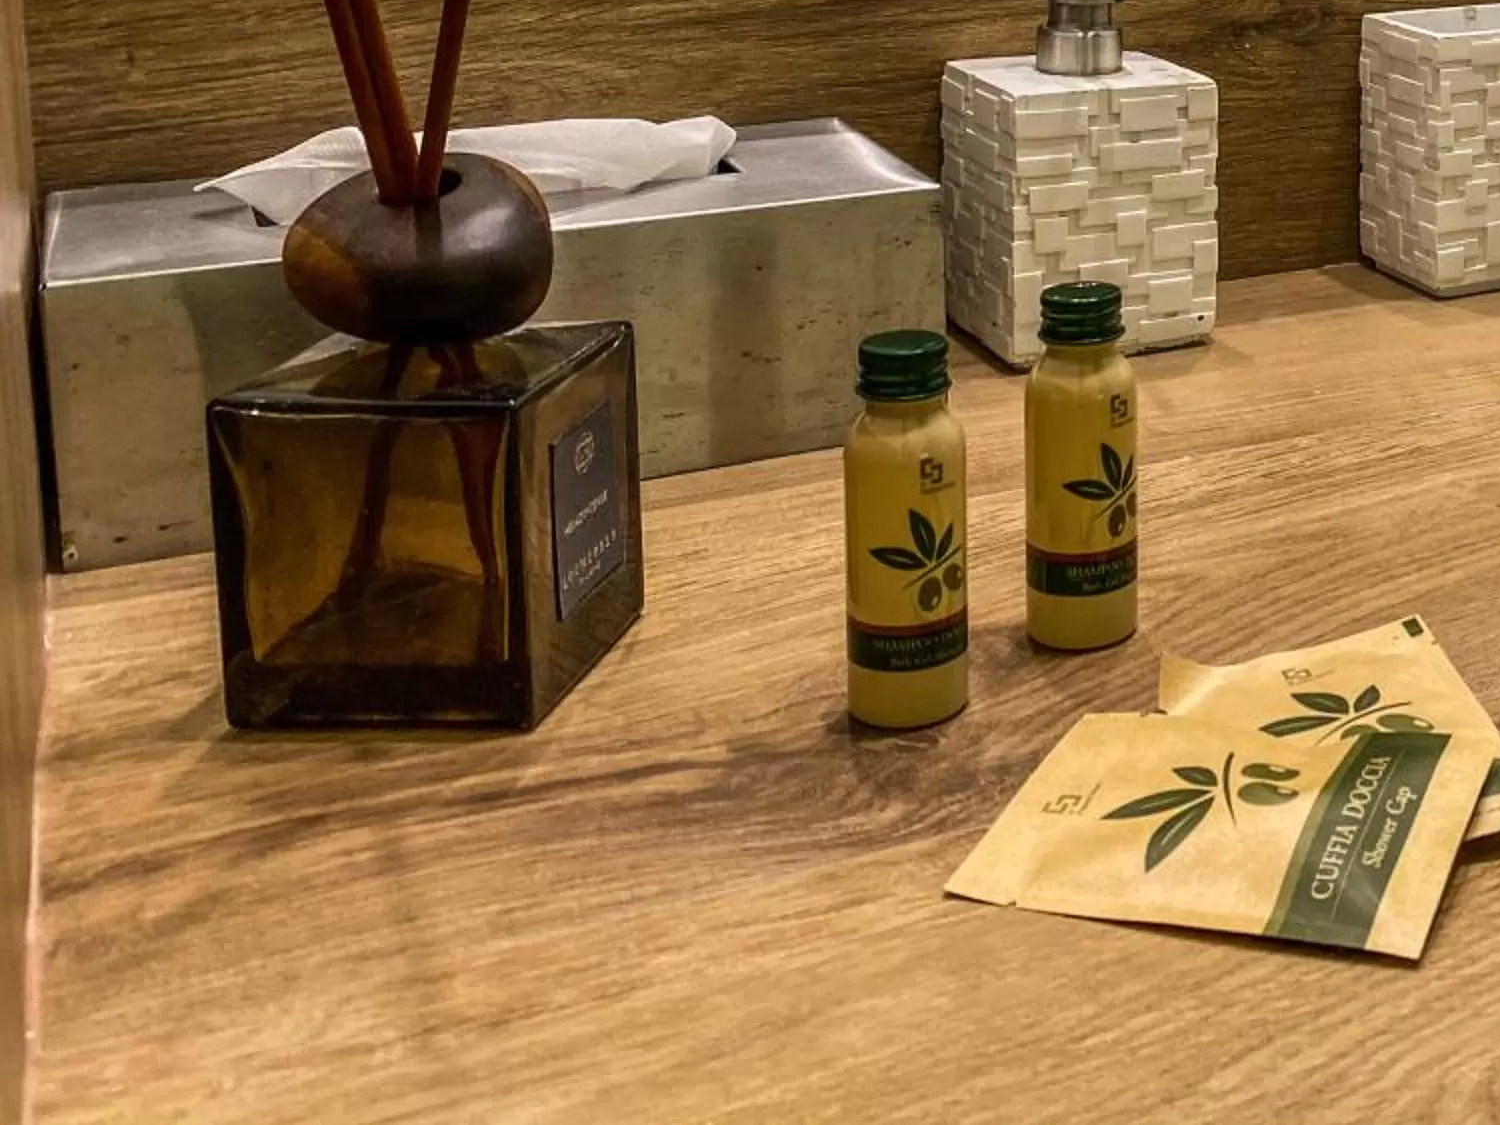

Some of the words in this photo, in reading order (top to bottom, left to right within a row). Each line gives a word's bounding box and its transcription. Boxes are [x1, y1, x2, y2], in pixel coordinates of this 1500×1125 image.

[1310, 825, 1358, 901] CUFFIA
[1340, 756, 1393, 820] DOCCIA
[1360, 816, 1399, 870] Shower
[1385, 786, 1419, 816] Cap
